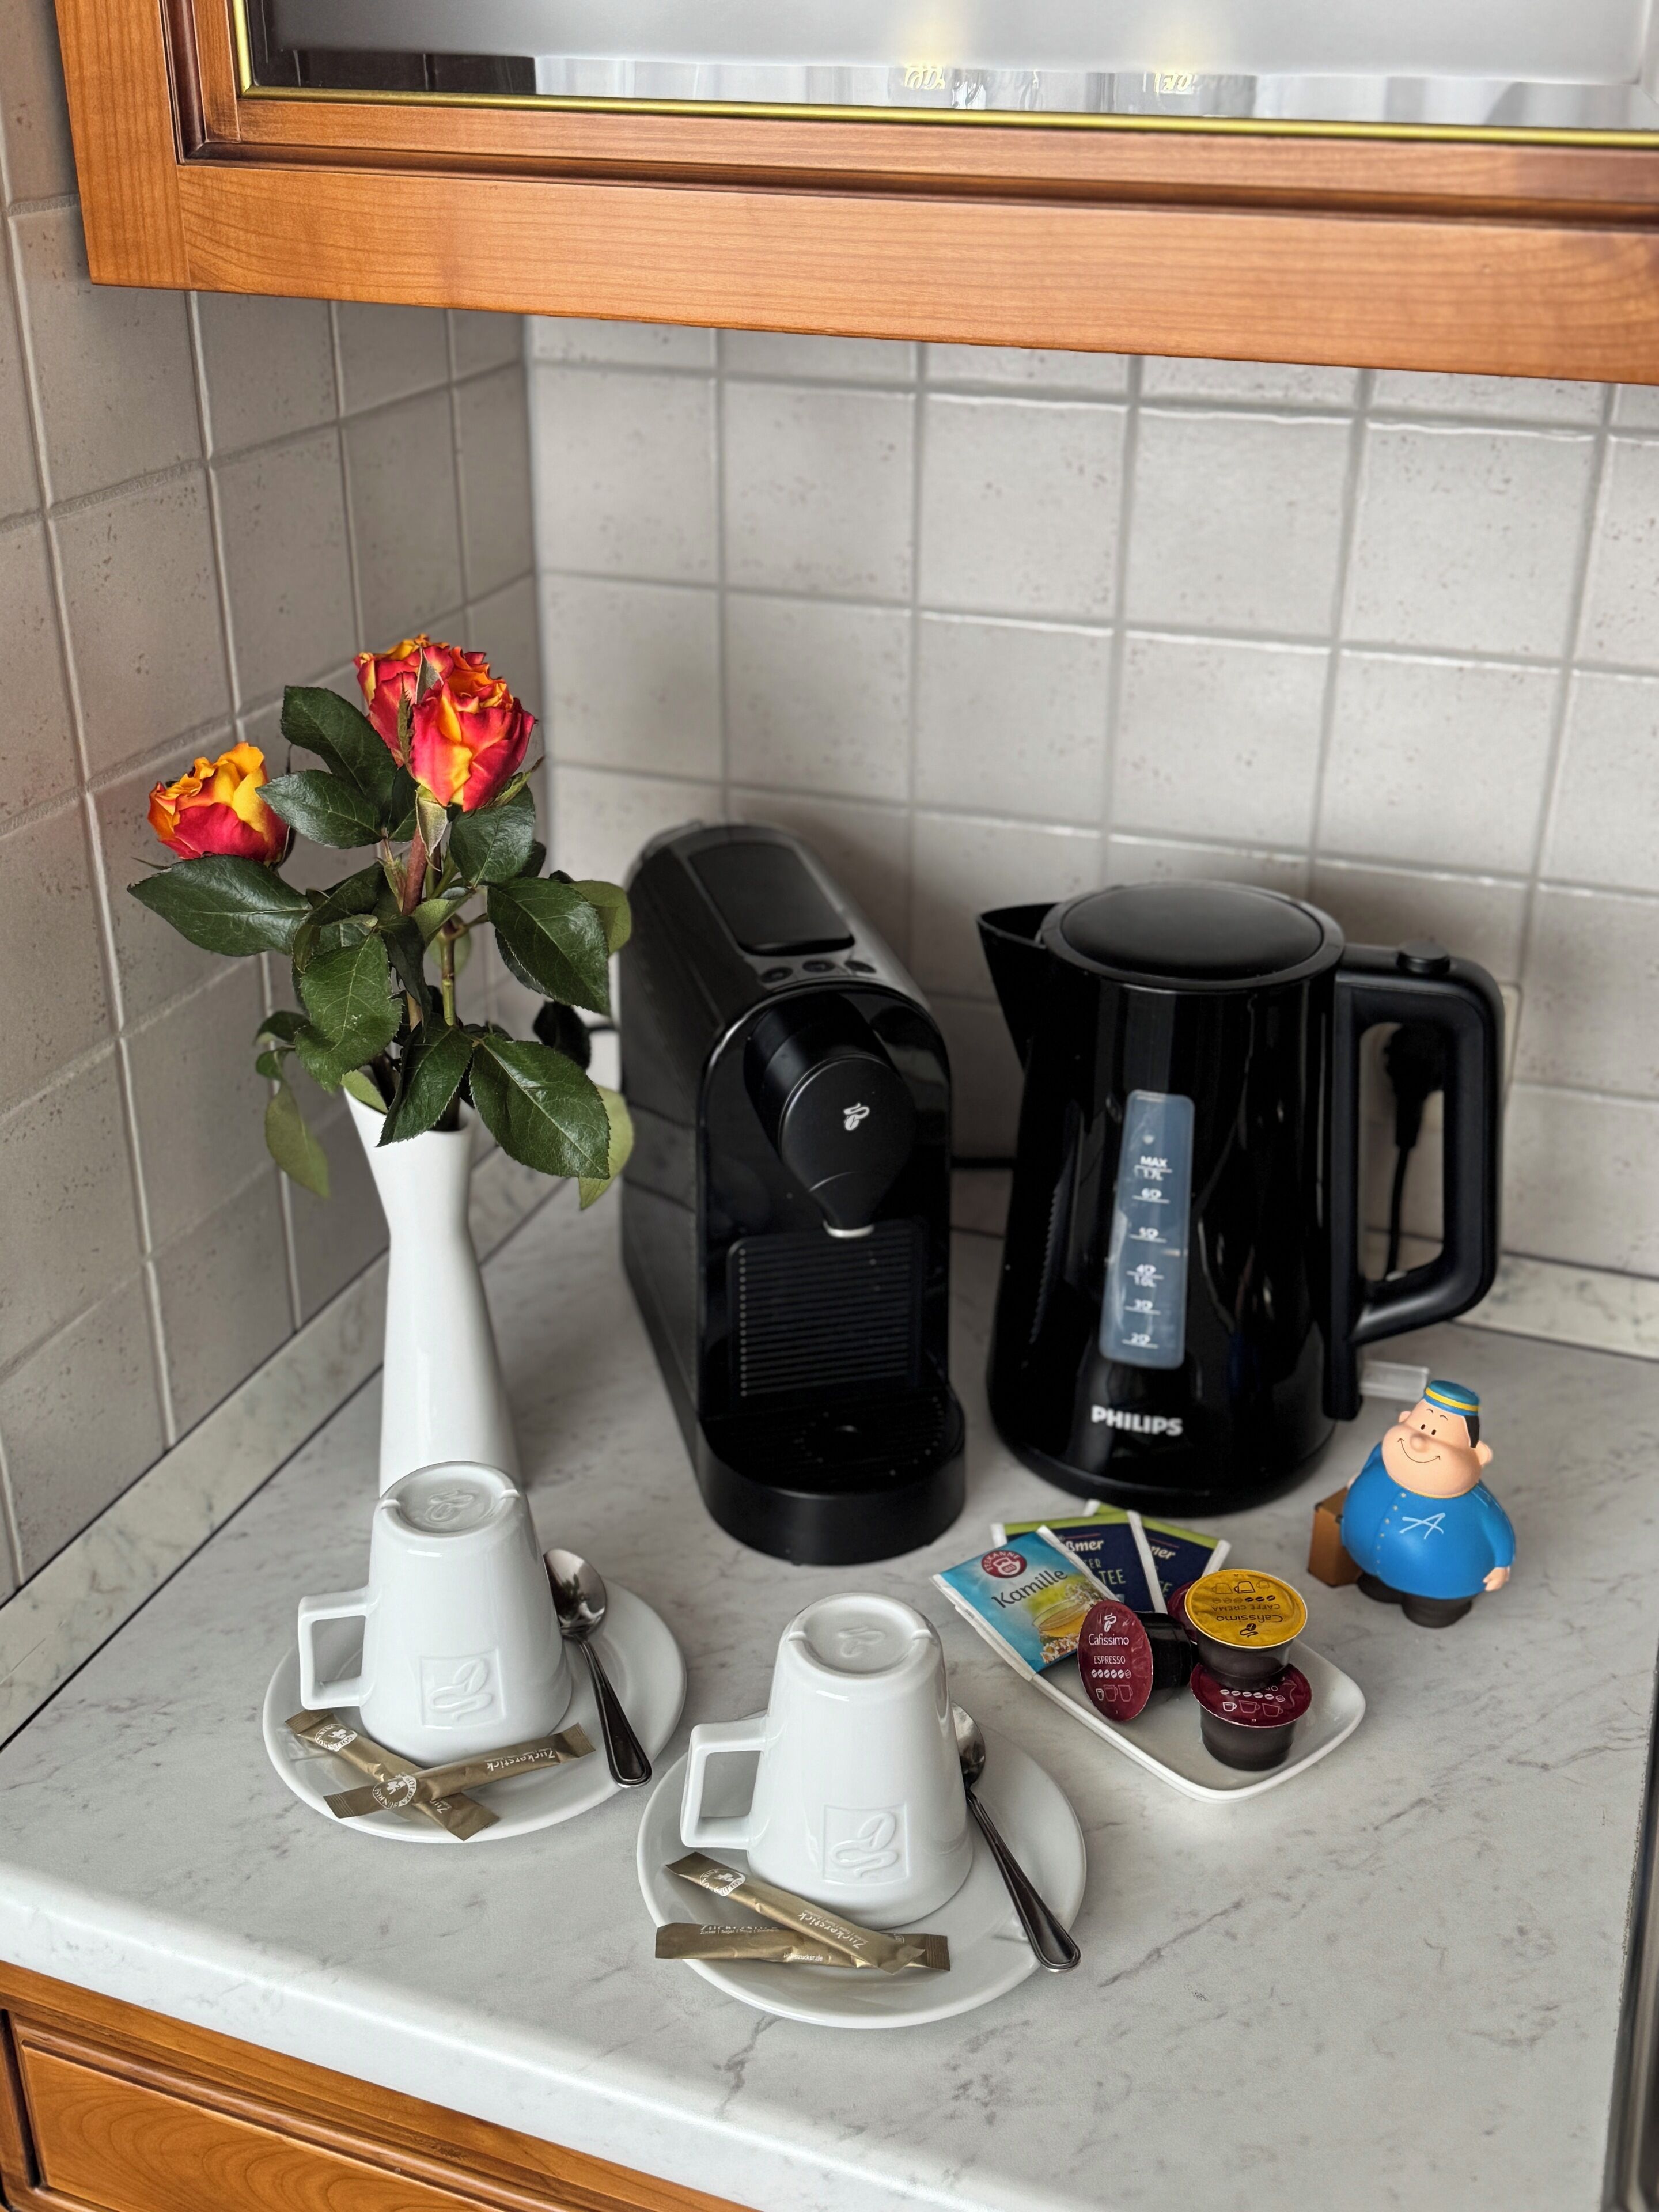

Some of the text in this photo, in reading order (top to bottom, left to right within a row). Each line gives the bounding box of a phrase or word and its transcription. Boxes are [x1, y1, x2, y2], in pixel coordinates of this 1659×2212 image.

[1140, 1156, 1168, 1168] MAX
[1091, 1405, 1183, 1435] PHILIPS
[1066, 1540, 1104, 1552] ßmer
[991, 1570, 1068, 1608] Kamille
[1216, 1615, 1283, 1623] Cafissimo
[1088, 1633, 1130, 1645] Cafissimo
[1094, 1656, 1126, 1664] ESPRESSO
[486, 1751, 556, 1771] Zuckerstick
[798, 1911, 865, 1949] Zuckerstick
